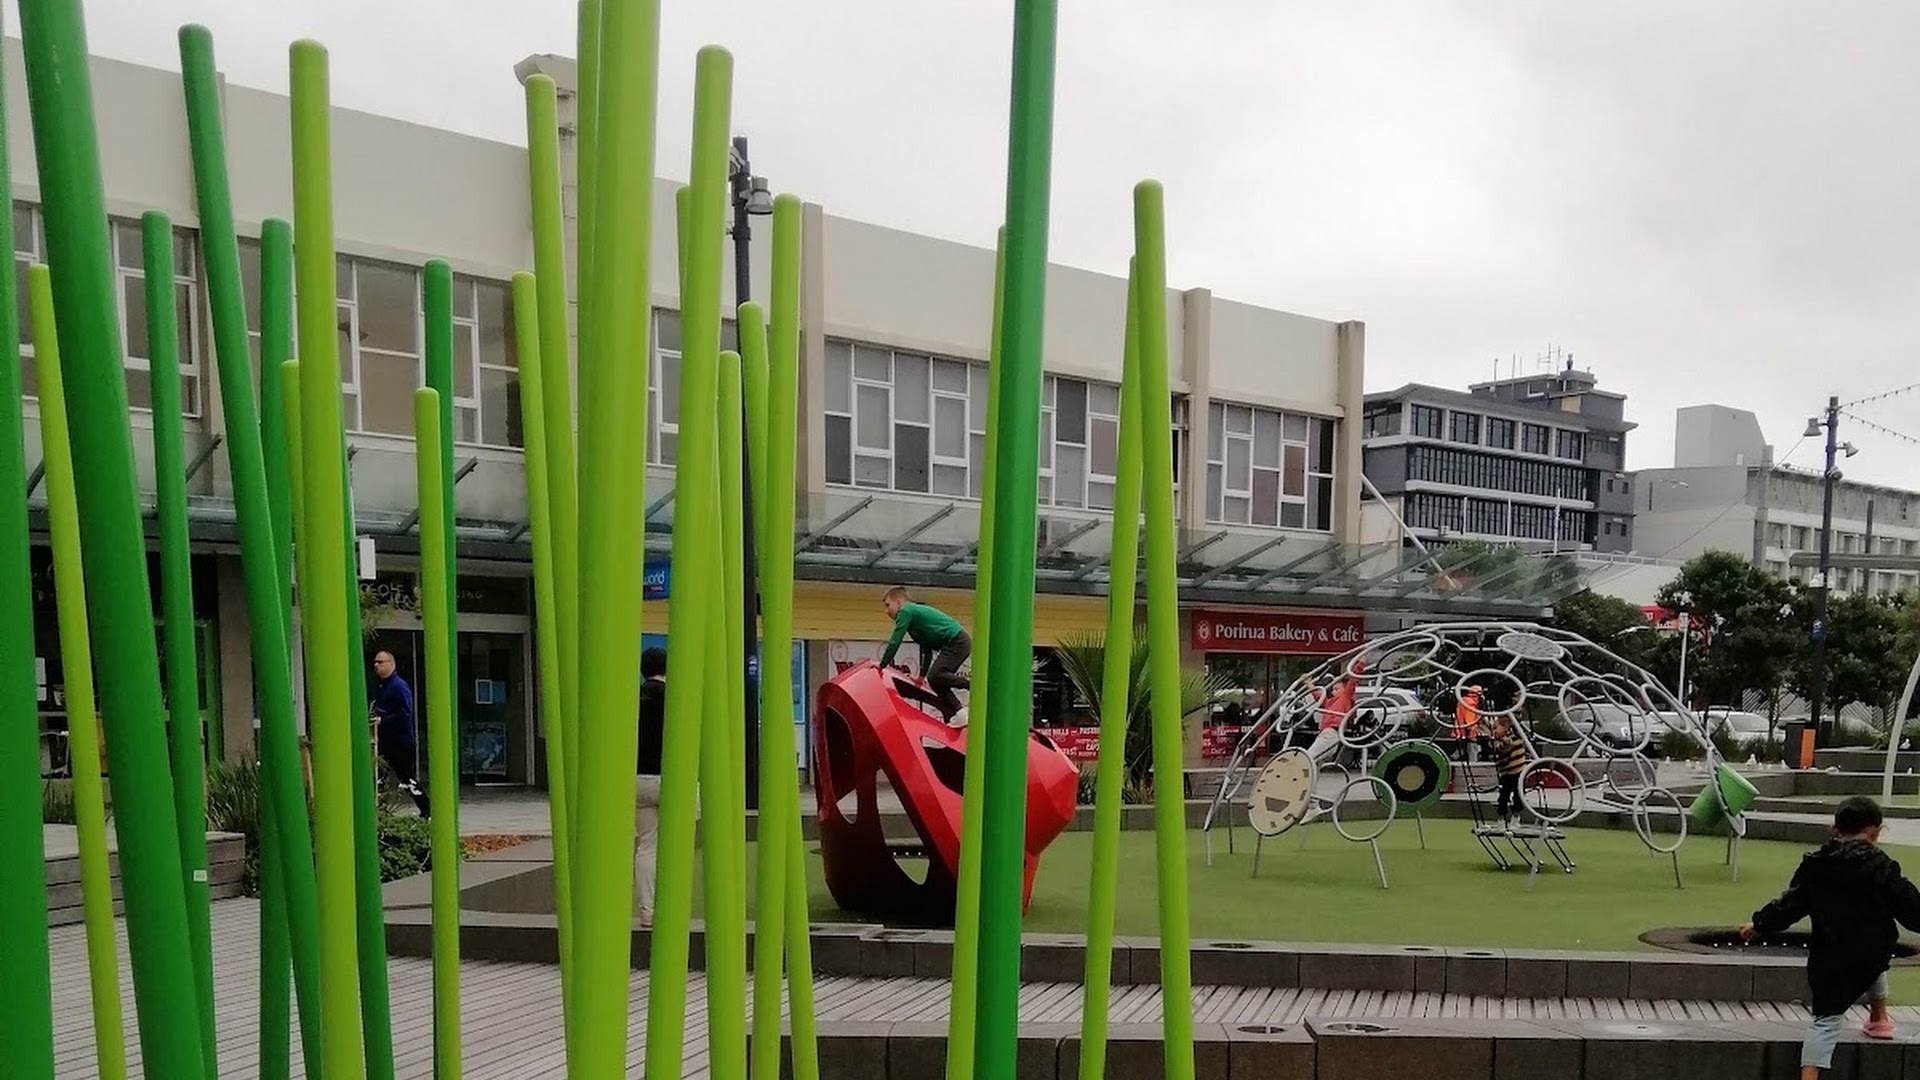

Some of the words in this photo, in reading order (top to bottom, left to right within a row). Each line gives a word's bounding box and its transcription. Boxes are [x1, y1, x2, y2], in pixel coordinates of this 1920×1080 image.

[1215, 622, 1265, 640] Porirua
[1270, 623, 1314, 646] Bakery
[1317, 628, 1329, 642] &
